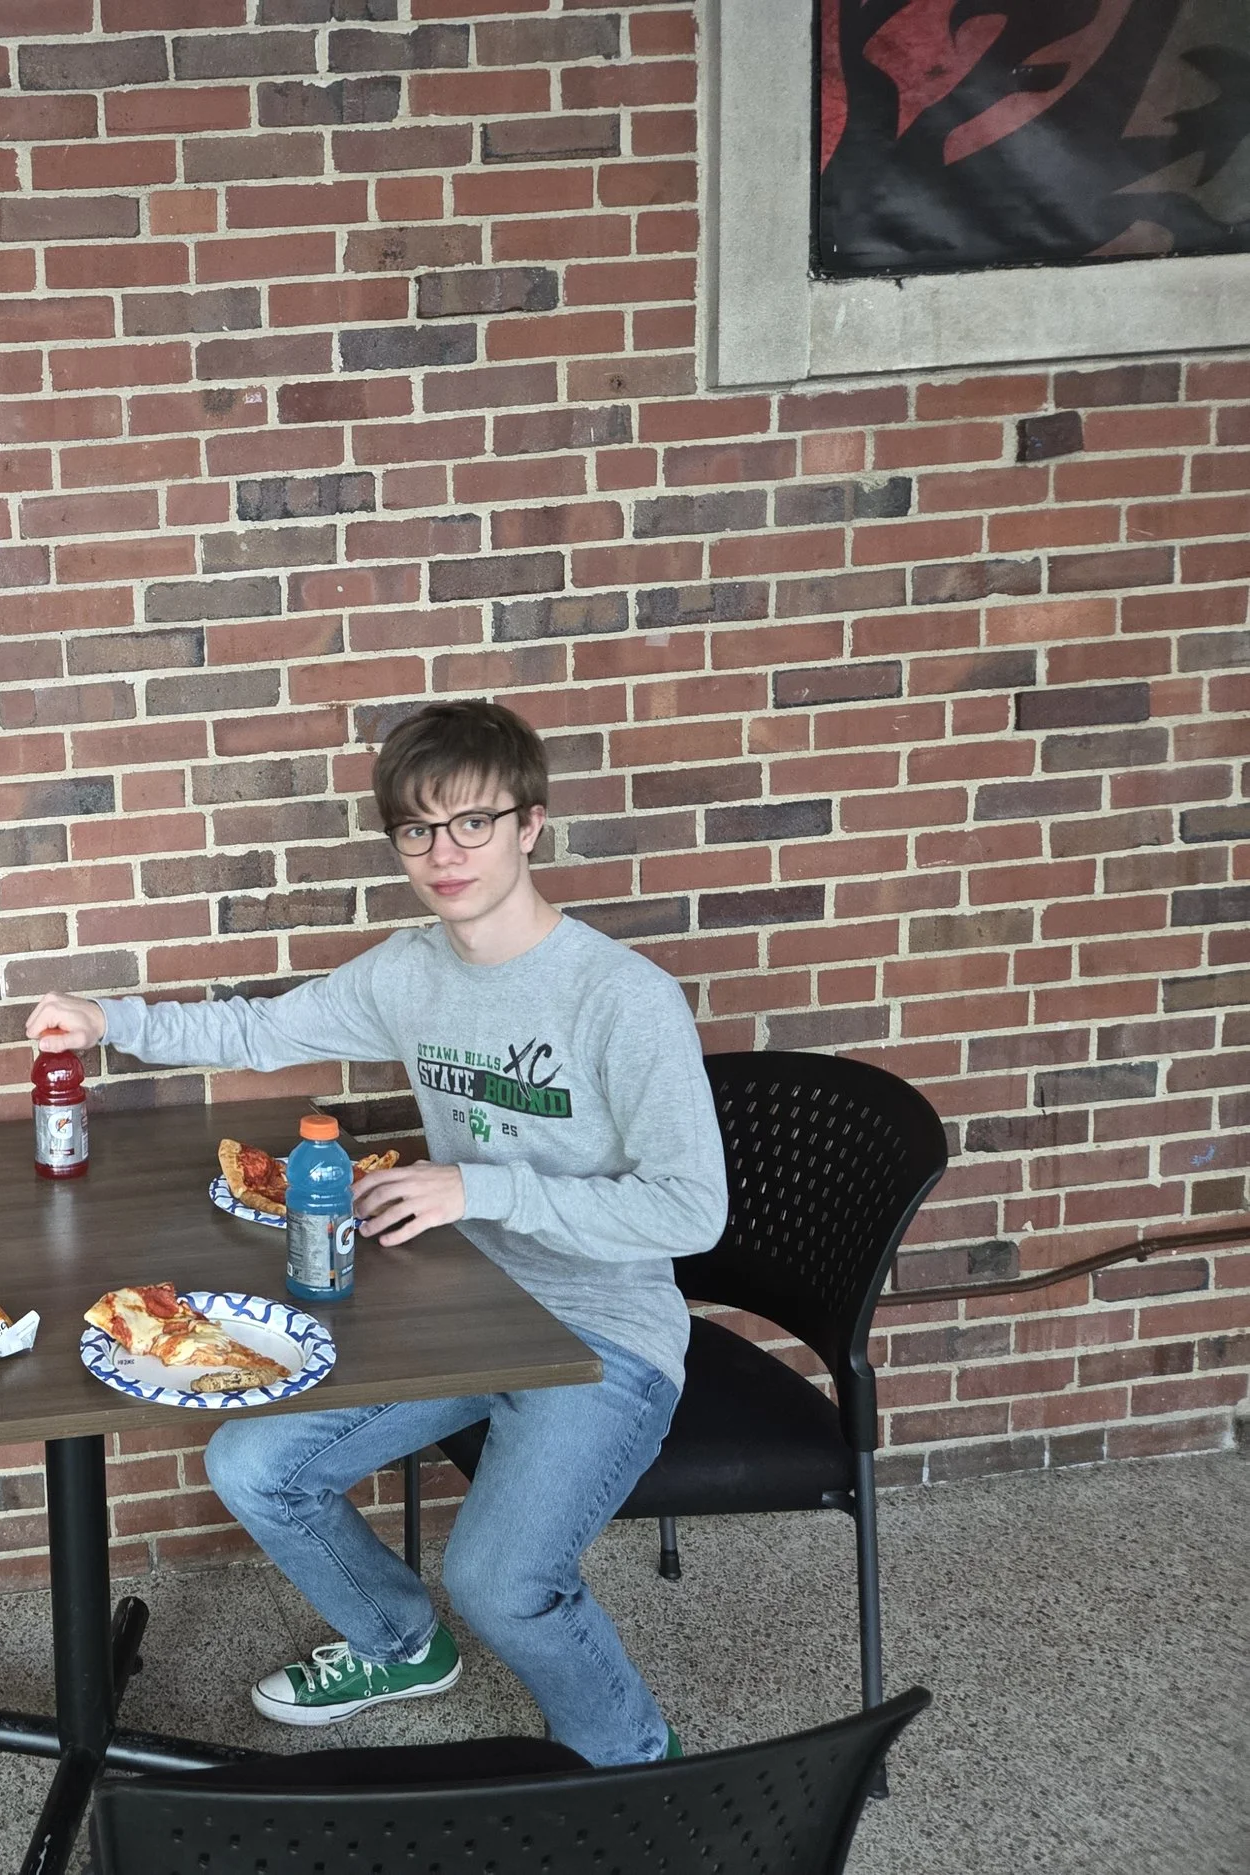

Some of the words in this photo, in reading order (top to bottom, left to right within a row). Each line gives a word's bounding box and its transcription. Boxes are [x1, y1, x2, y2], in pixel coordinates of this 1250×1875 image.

[417, 1042, 459, 1063] OTTAWA
[464, 1050, 501, 1071] HILLS
[502, 1036, 563, 1101] XC
[418, 1060, 475, 1098] STATE
[484, 1073, 568, 1117] BOUND
[48, 1110, 73, 1140] G
[452, 1109, 465, 1124] 20
[501, 1123, 518, 1137] 25
